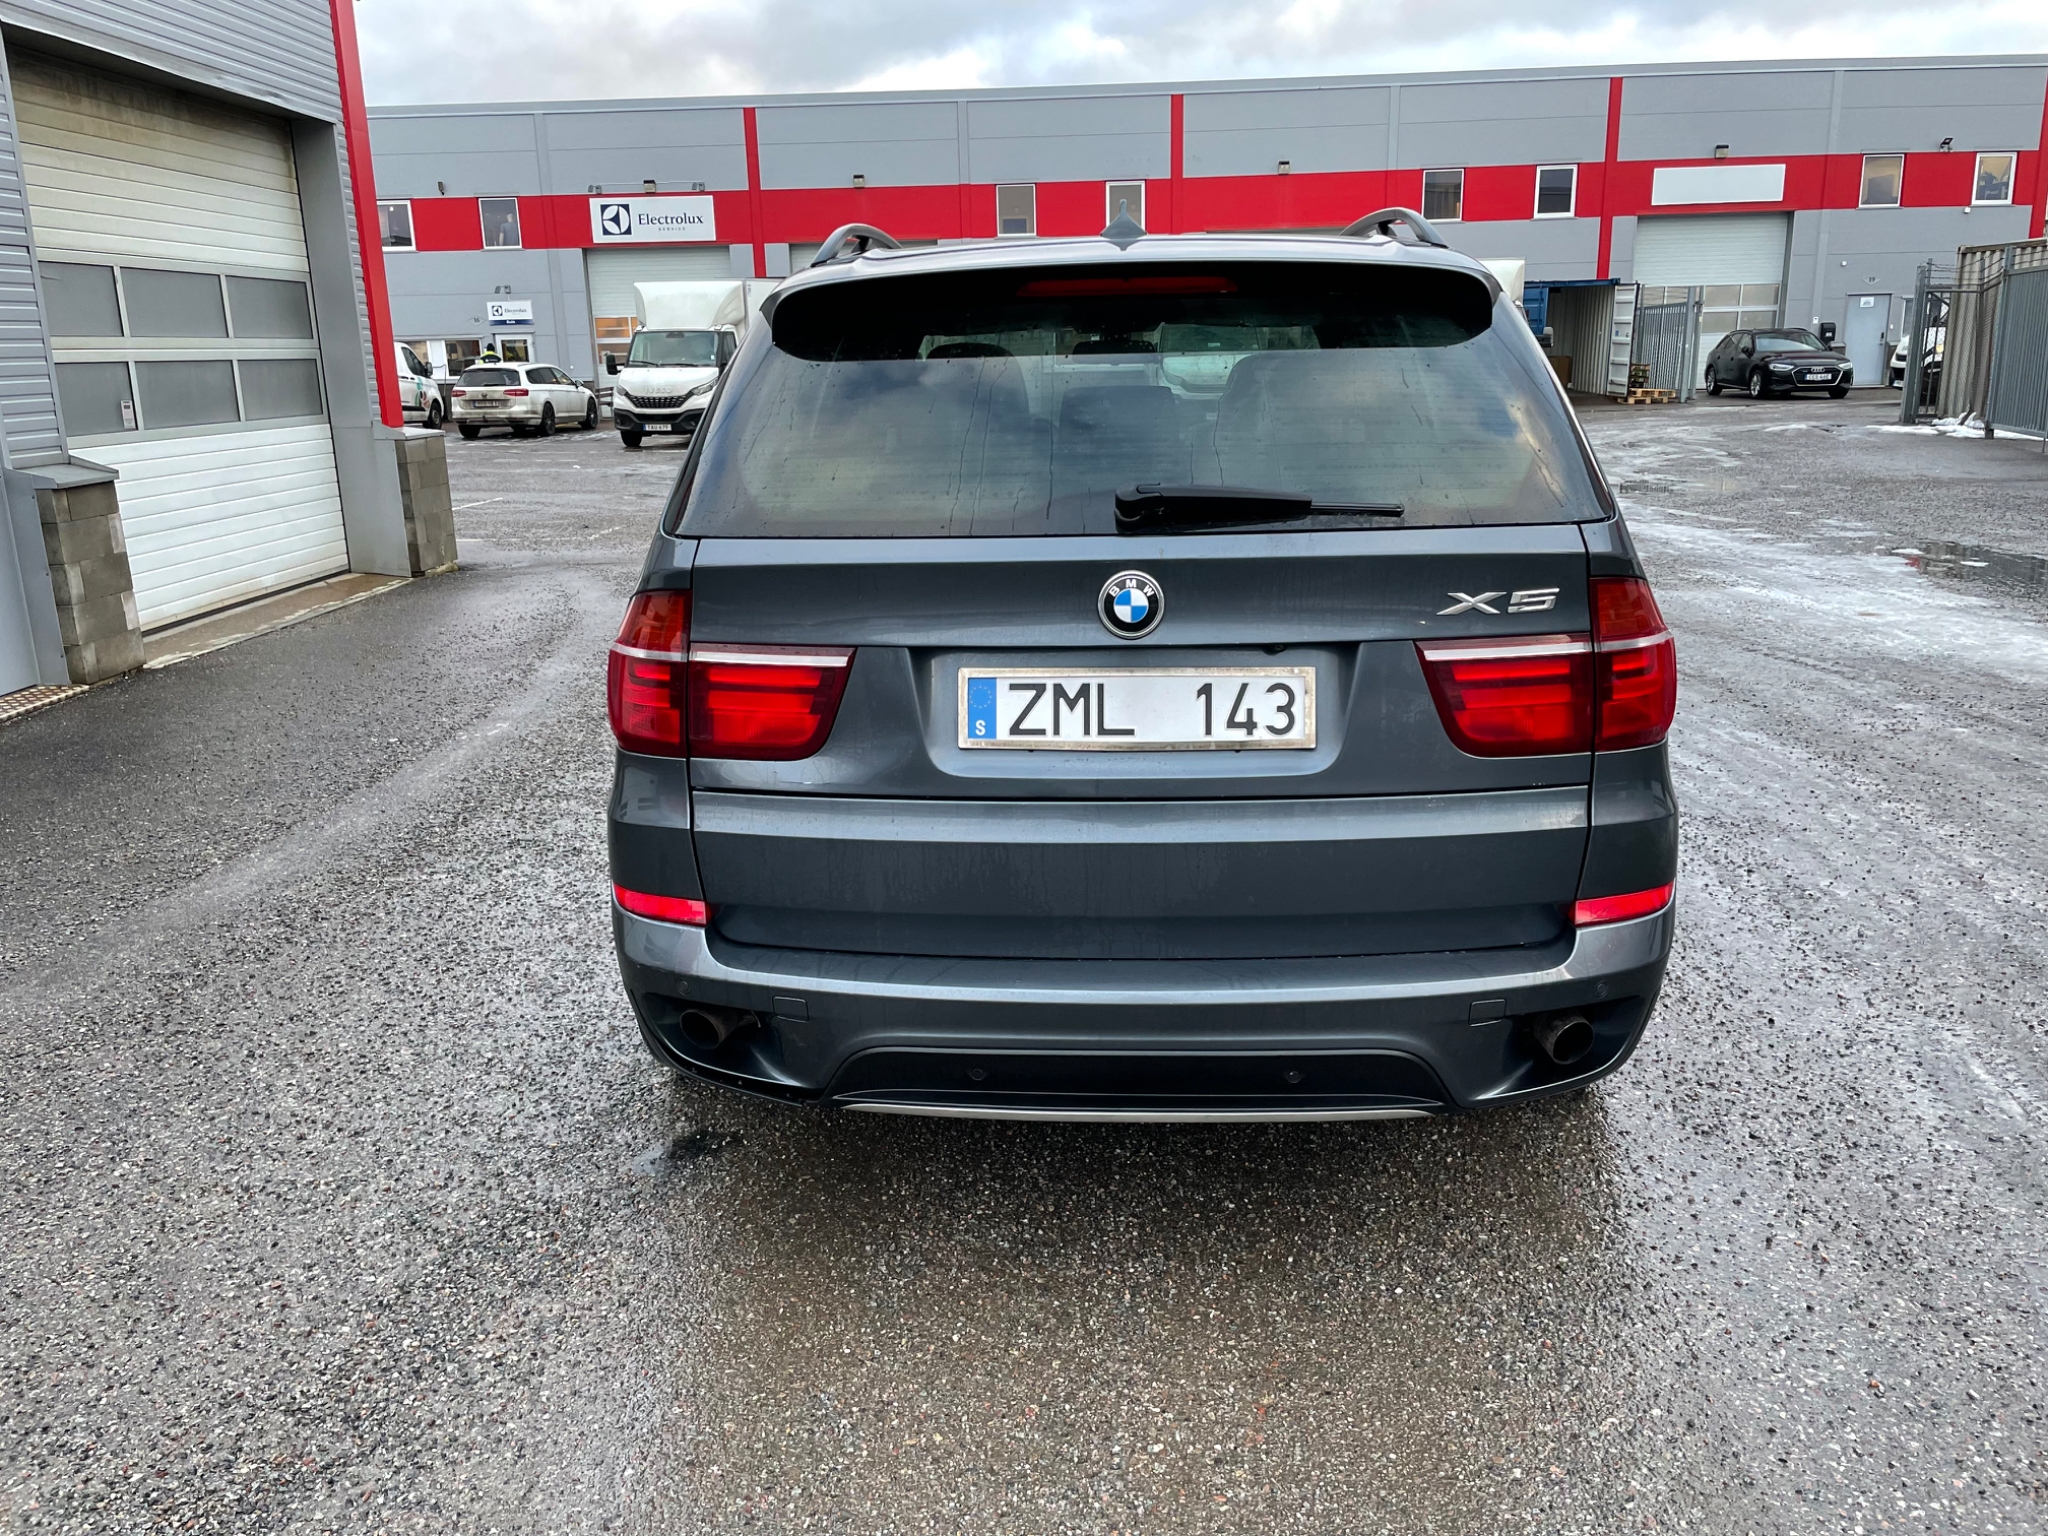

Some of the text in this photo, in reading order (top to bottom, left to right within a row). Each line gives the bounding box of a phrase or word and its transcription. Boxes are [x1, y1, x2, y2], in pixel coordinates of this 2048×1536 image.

[638, 212, 704, 225] Electrolux
[1108, 578, 1155, 597] BMW
[1436, 587, 1560, 616] X5
[1008, 682, 1296, 736] ZML 143
[975, 720, 986, 736] S
